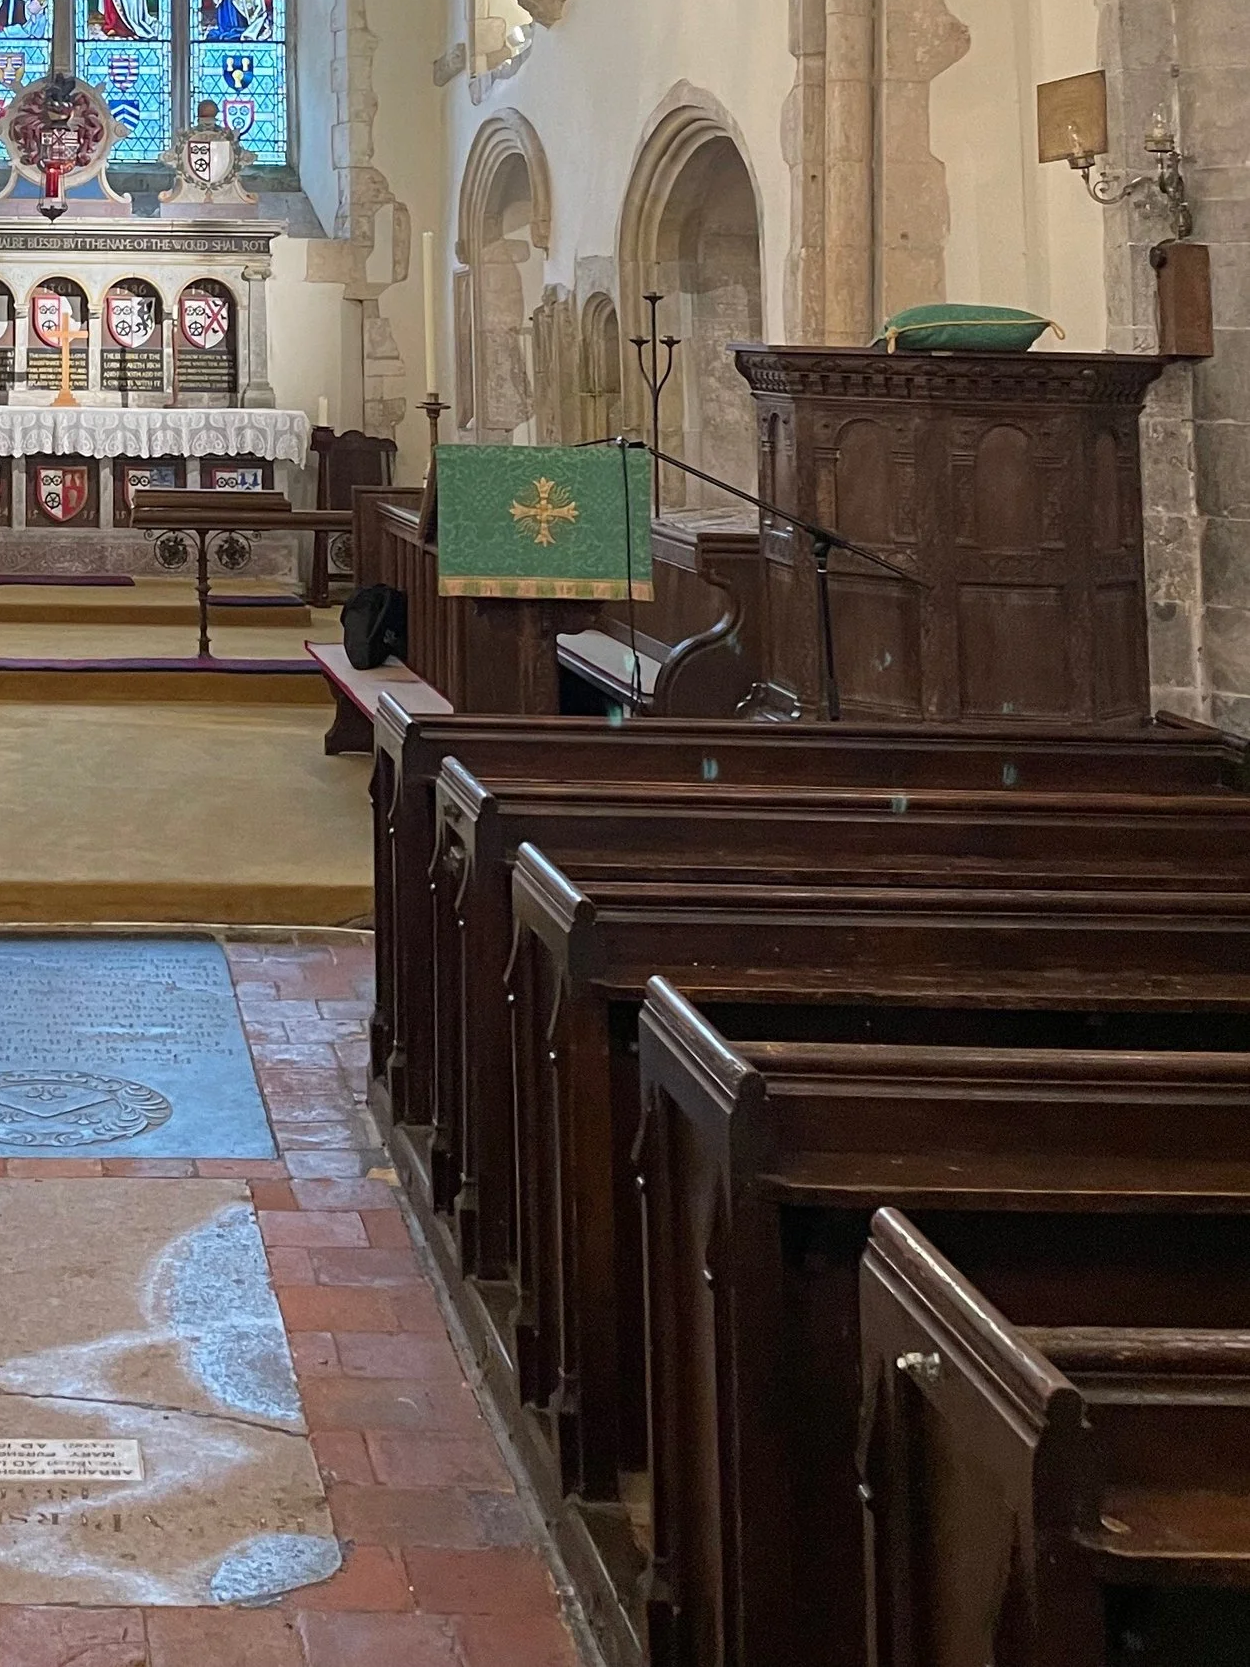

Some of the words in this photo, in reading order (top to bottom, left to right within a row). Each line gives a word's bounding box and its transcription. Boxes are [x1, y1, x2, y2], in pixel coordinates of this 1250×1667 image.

[84, 237, 108, 250] THE
[107, 237, 132, 251] NAME
[134, 237, 149, 251] OF
[150, 238, 171, 251] THE
[171, 238, 208, 251] WICKED
[212, 239, 239, 252] SHAL
[69, 1450, 116, 1458] MARY
[52, 1468, 134, 1476] ABRAHAM
